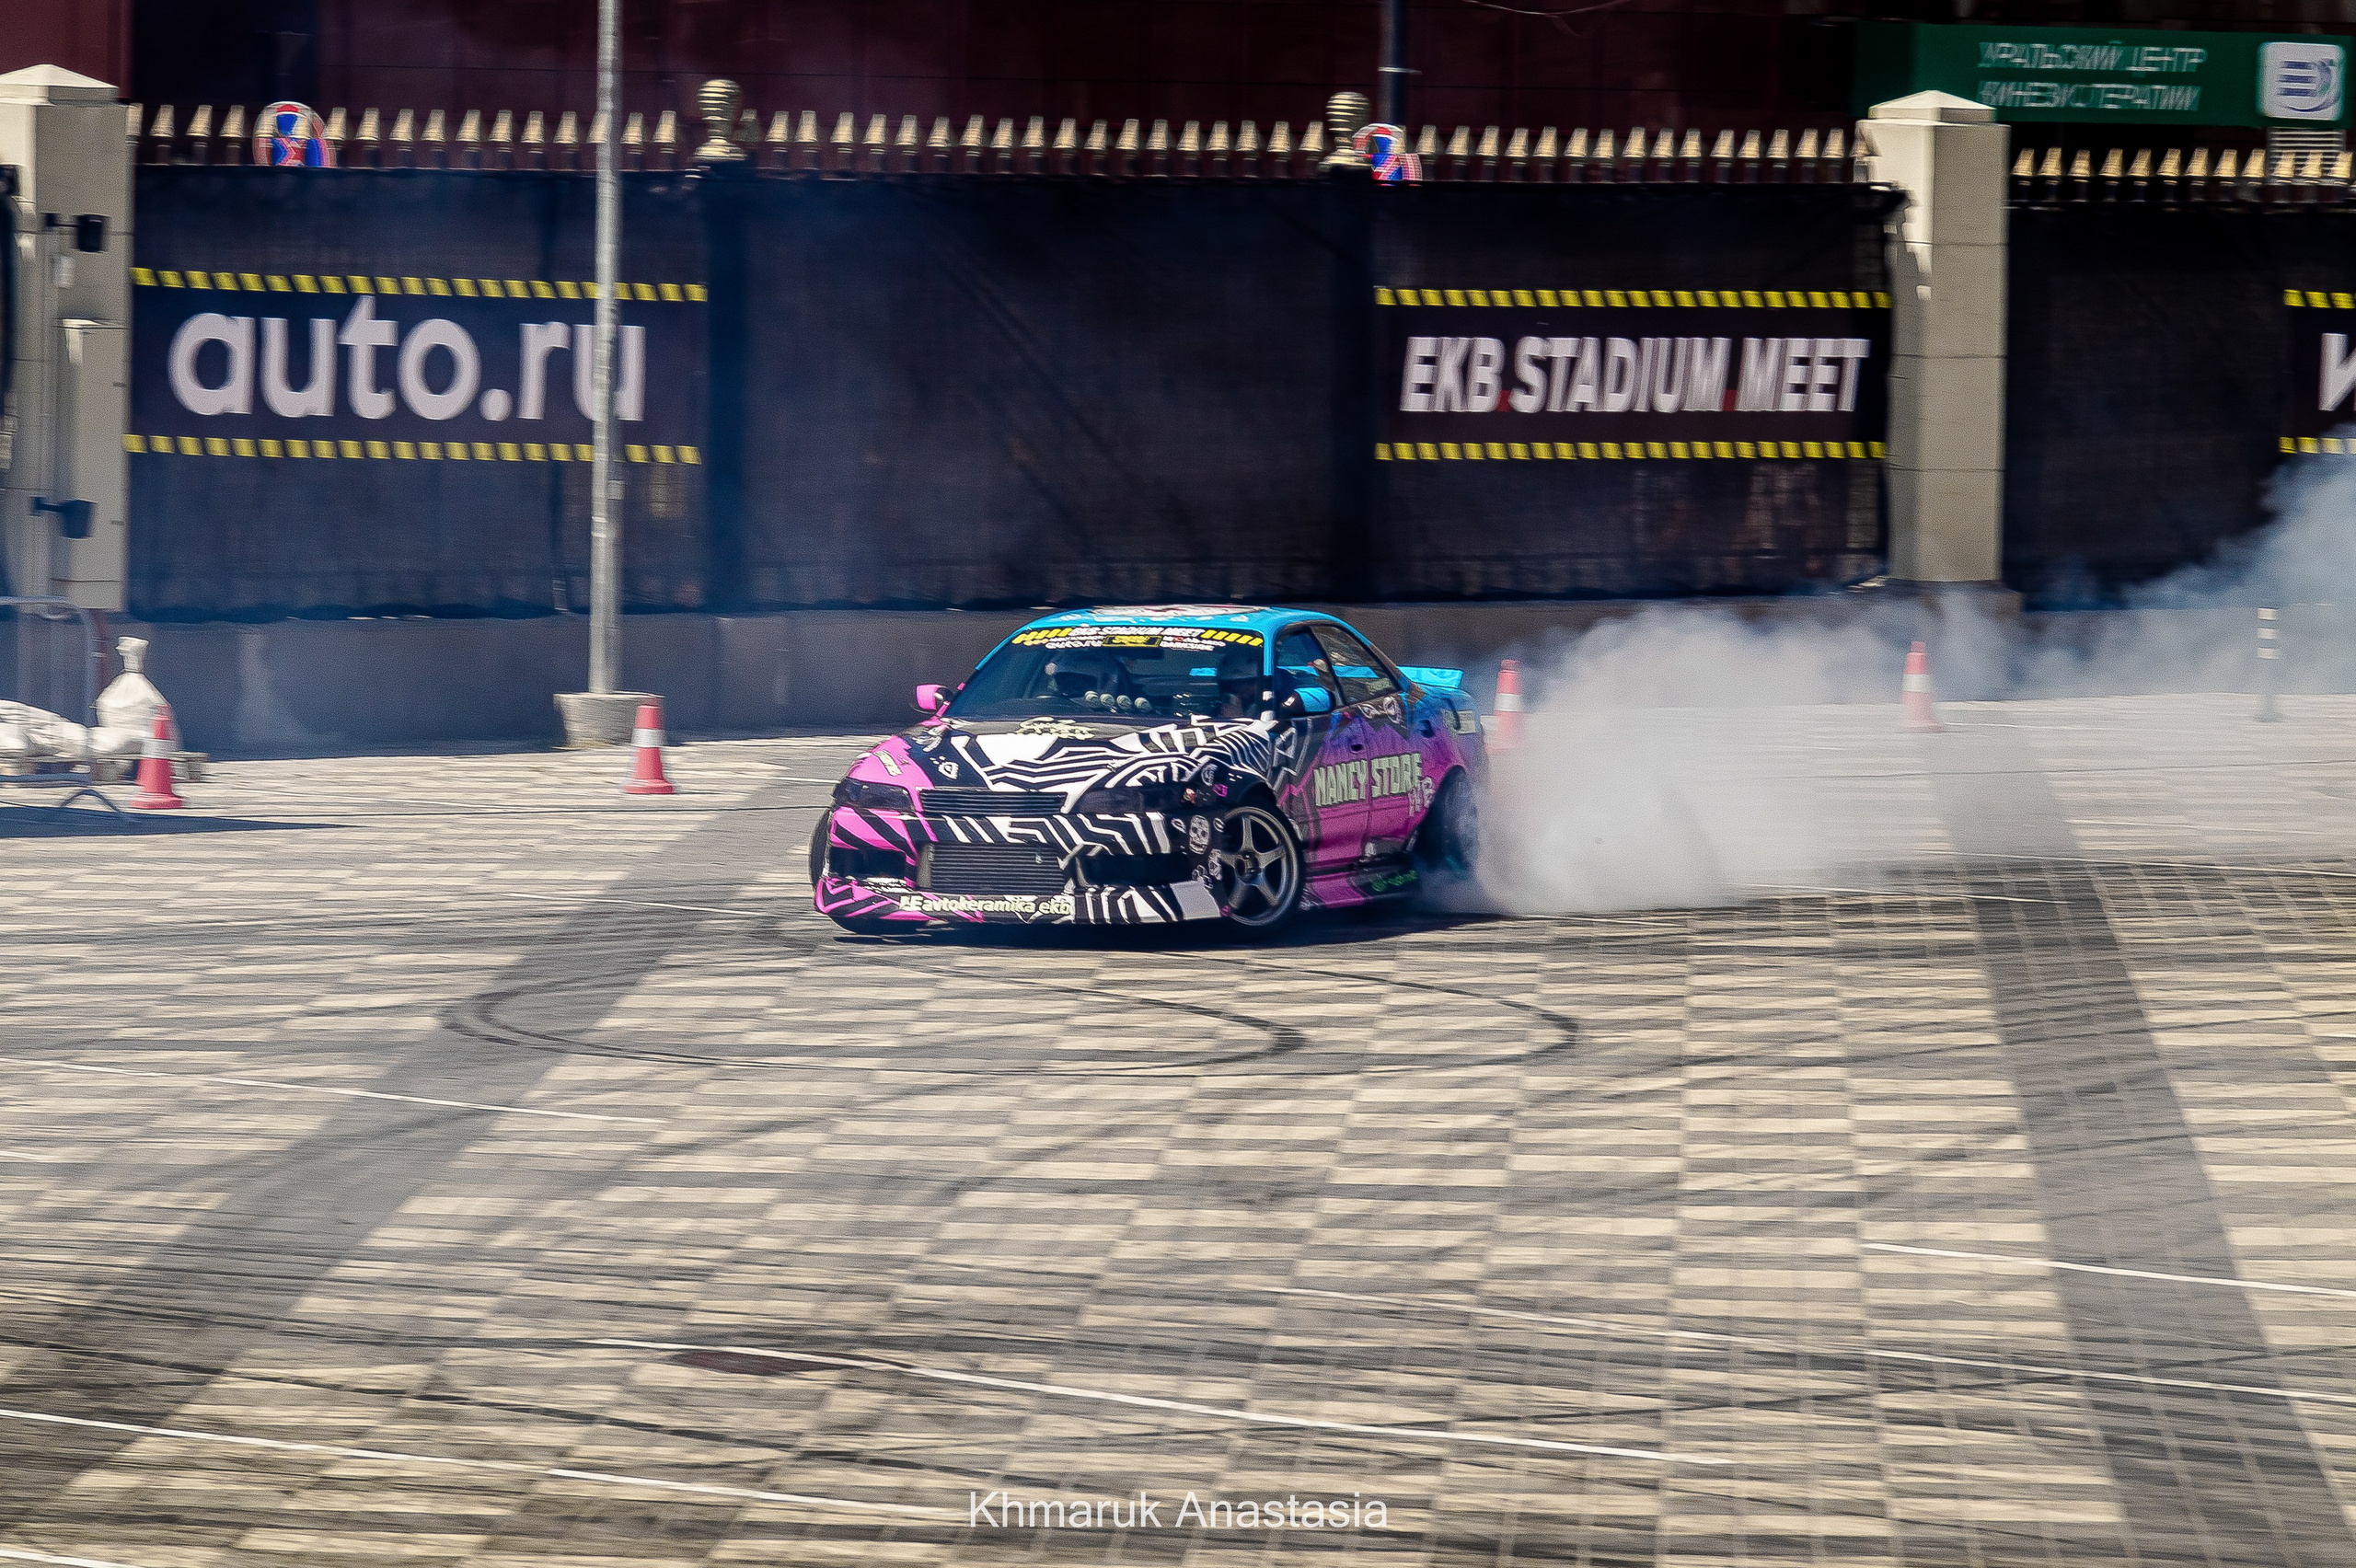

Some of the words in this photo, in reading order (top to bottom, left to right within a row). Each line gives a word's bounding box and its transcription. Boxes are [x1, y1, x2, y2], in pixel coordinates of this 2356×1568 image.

[2125, 47, 2208, 78] ЦЕНТР
[167, 295, 644, 421] auto.ru
[1400, 337, 1505, 412] EKB
[1507, 336, 1732, 413] STADIUM
[1736, 337, 1871, 412] MEET
[1313, 759, 1369, 807] NANCY
[1370, 752, 1423, 799] STORE
